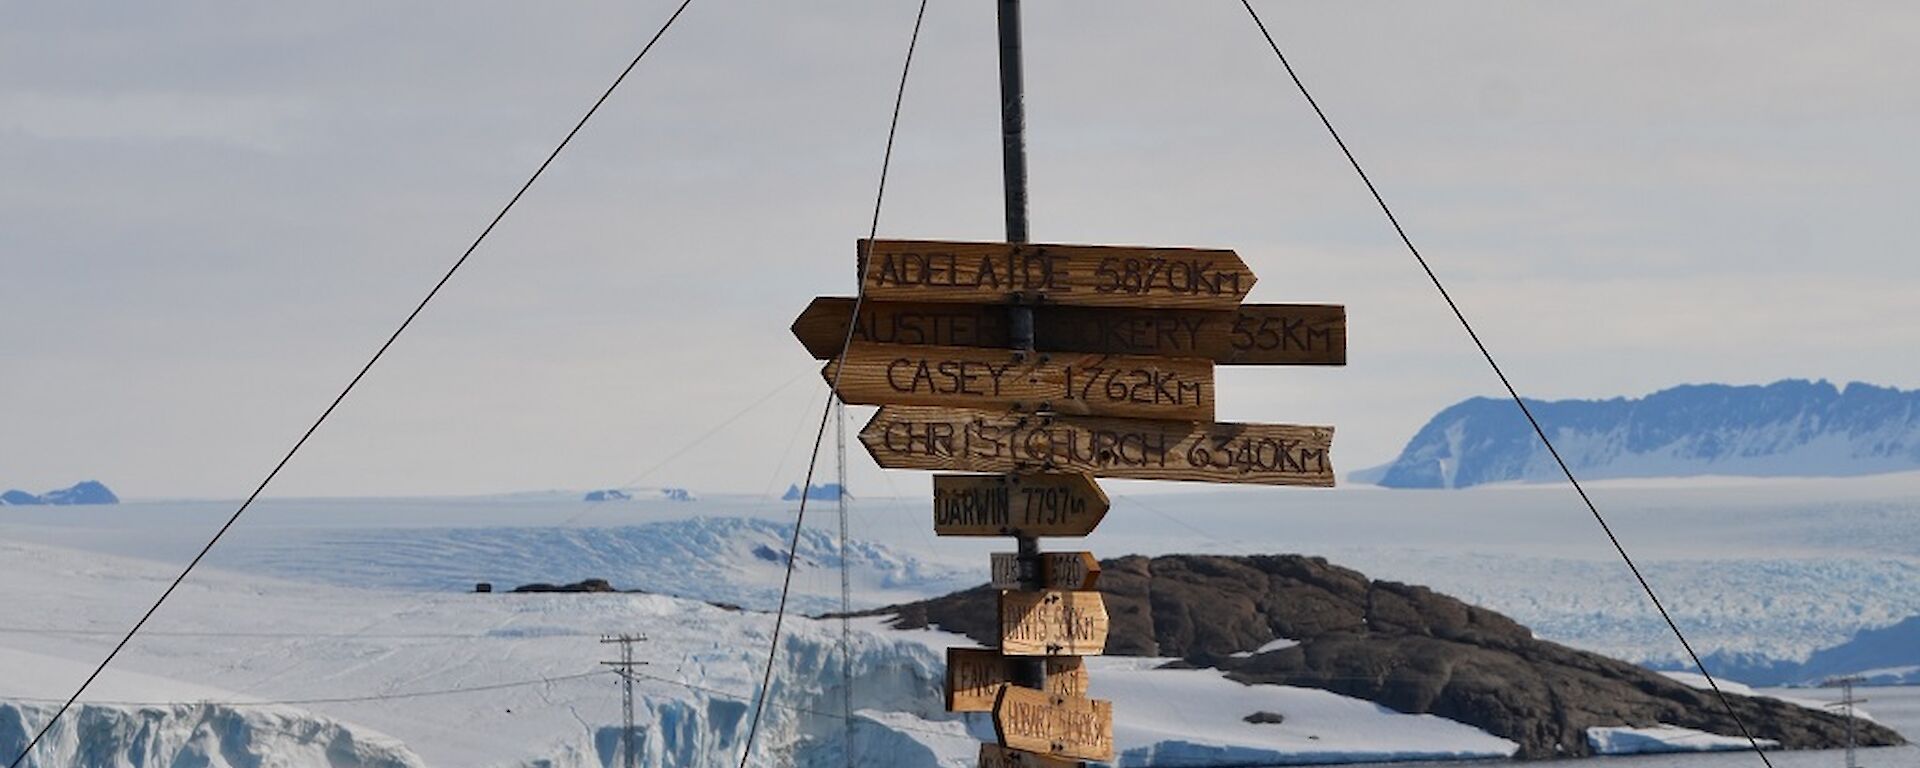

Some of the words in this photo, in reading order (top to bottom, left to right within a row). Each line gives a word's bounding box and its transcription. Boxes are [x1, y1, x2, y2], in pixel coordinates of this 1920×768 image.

[877, 252, 1072, 292] ADELAIDE
[887, 357, 1017, 396] CASEY
[884, 420, 1165, 468] CHRISTCHURCH
[936, 487, 1010, 526] DARWIN
[1005, 603, 1047, 642] DAVIS
